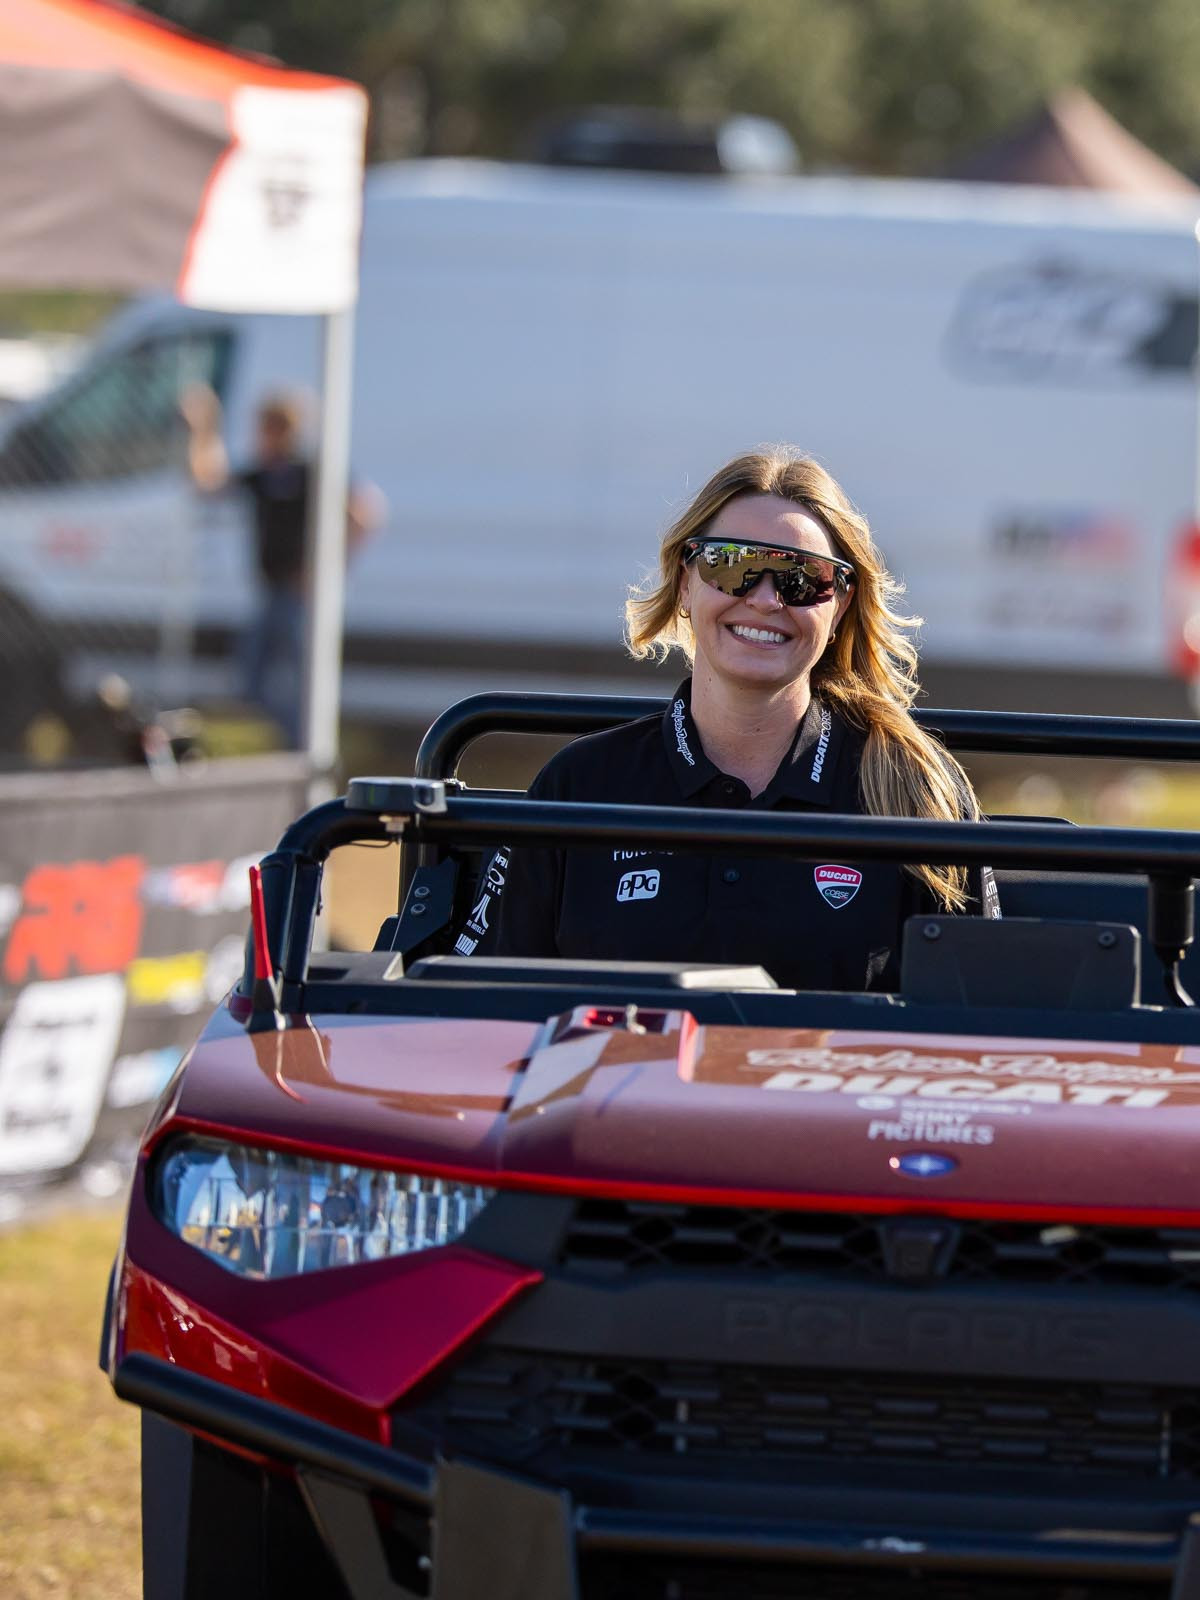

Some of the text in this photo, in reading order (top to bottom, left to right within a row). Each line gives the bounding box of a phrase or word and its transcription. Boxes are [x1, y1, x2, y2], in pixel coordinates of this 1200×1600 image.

[819, 870, 858, 882] DUCATI
[824, 888, 849, 898] CORSE
[762, 1071, 1170, 1108] DUCATI
[867, 1119, 994, 1146] PICTURES
[720, 1295, 1118, 1365] POLARIS
